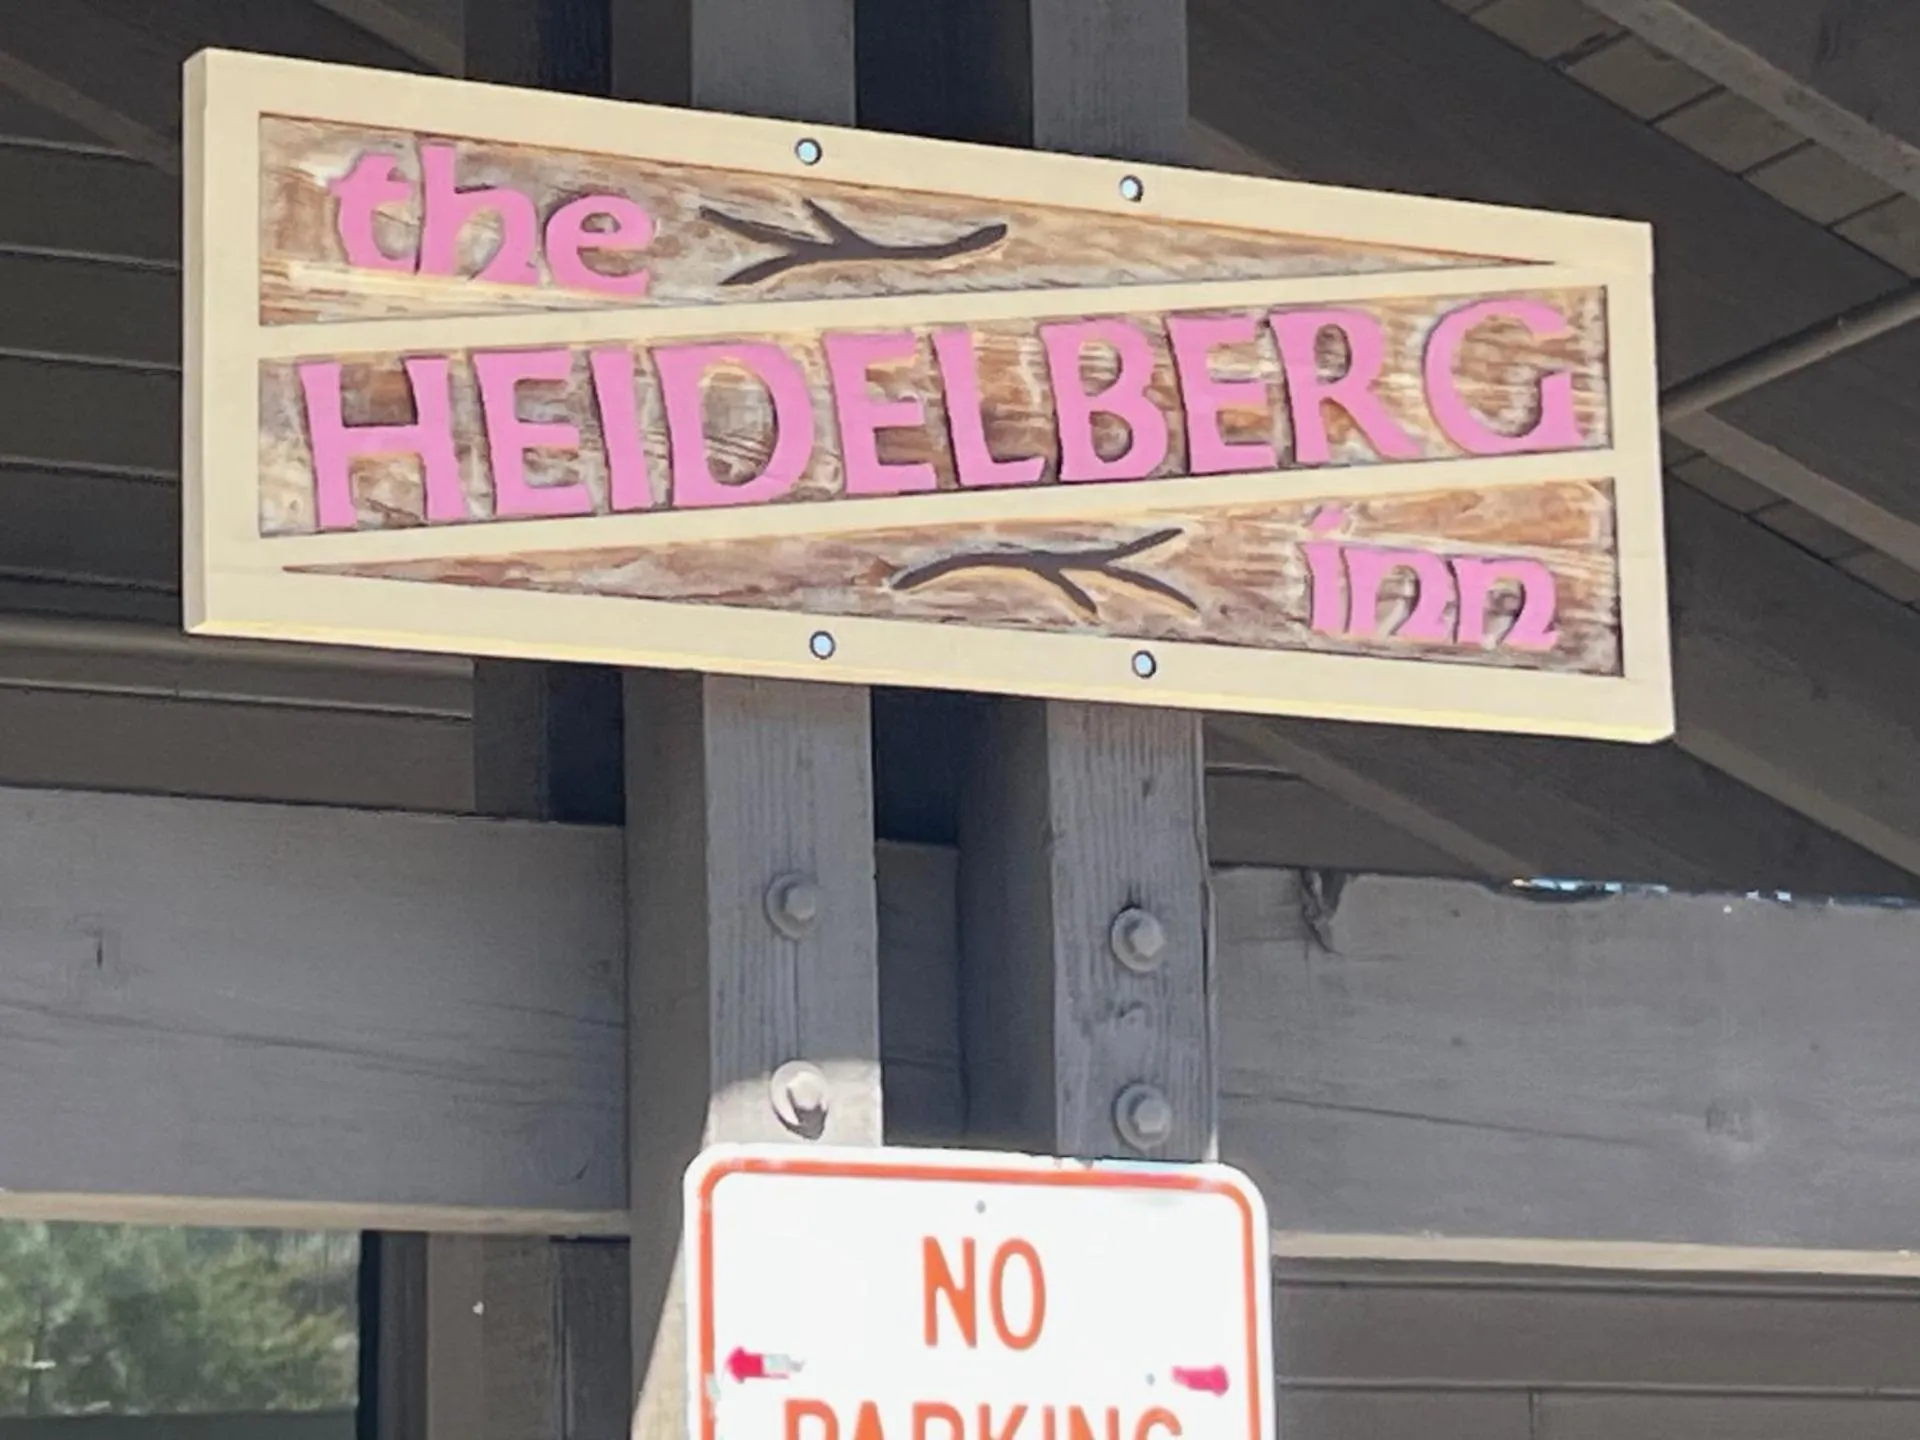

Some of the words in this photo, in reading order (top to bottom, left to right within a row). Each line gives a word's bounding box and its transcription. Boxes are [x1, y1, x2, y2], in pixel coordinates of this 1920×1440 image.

[333, 142, 653, 300] the
[300, 300, 1582, 529] HEIDELBERG
[1304, 504, 1557, 650] inn
[921, 1235, 1047, 1351] NO
